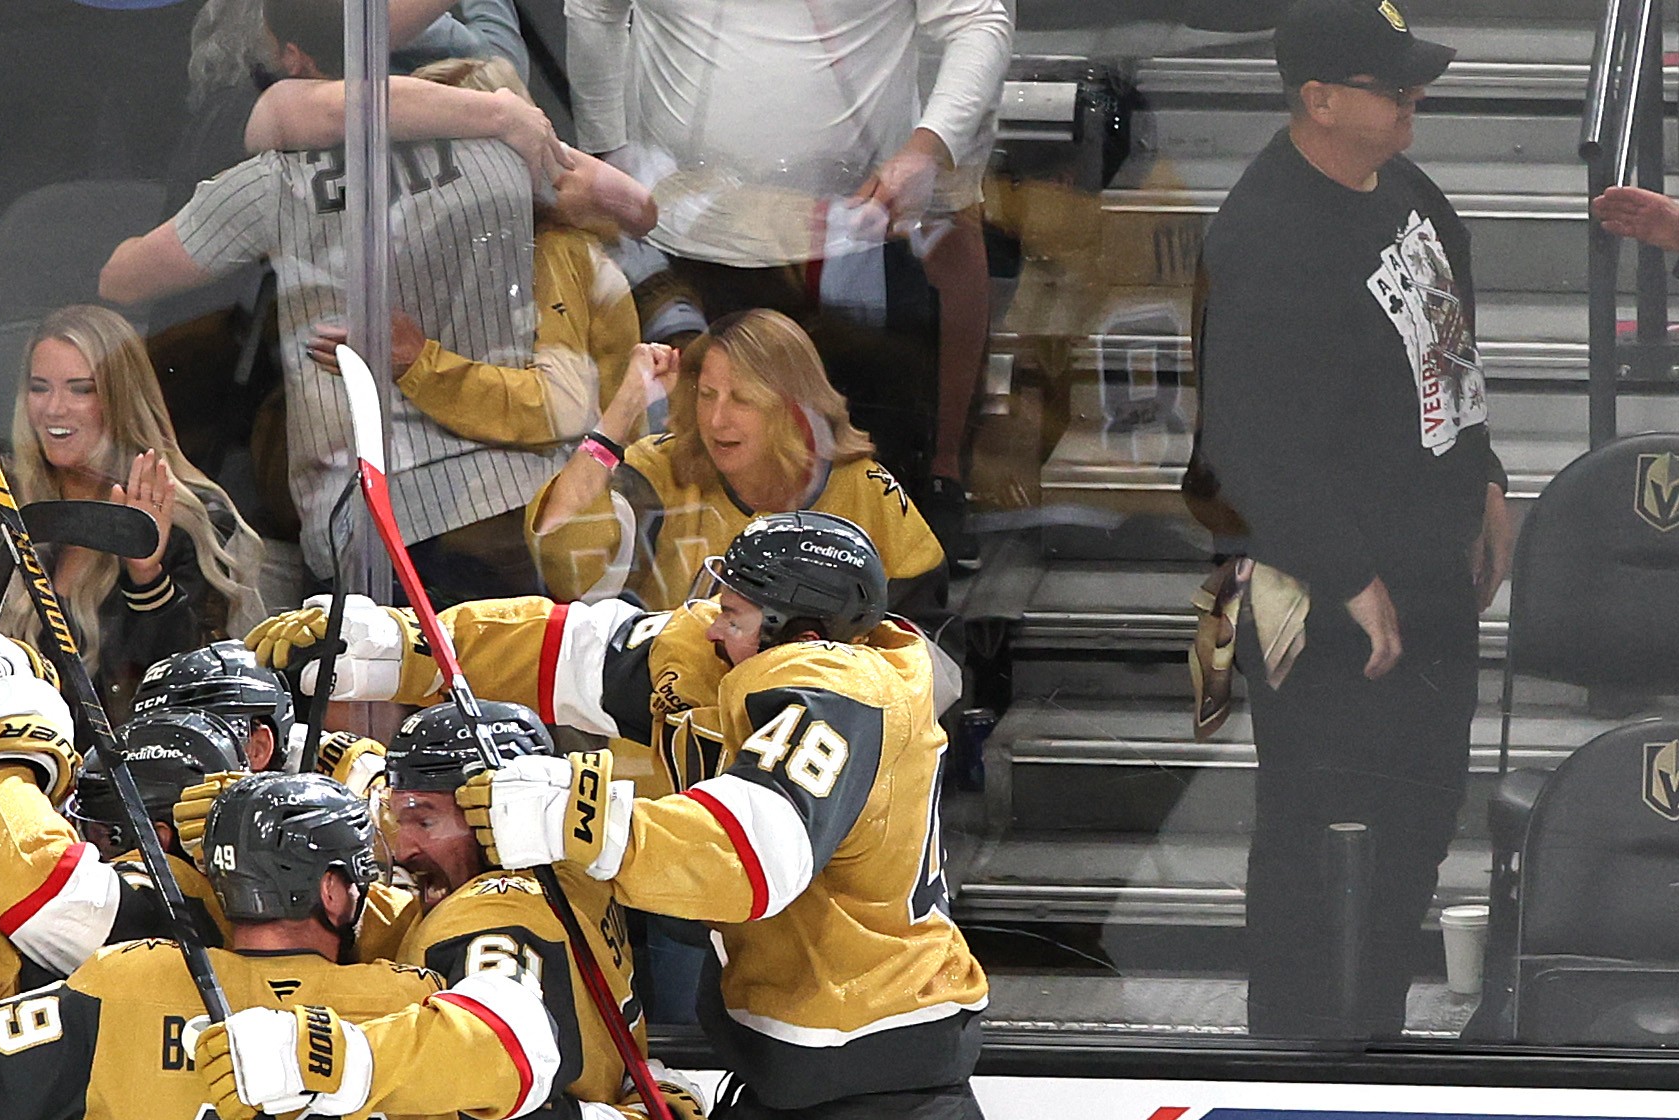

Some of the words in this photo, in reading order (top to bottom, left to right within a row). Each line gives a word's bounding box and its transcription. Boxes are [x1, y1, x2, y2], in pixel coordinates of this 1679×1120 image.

[799, 540, 866, 568] CreditOne
[134, 693, 169, 713] CCM
[741, 702, 850, 799] 48
[213, 845, 236, 871] 49
